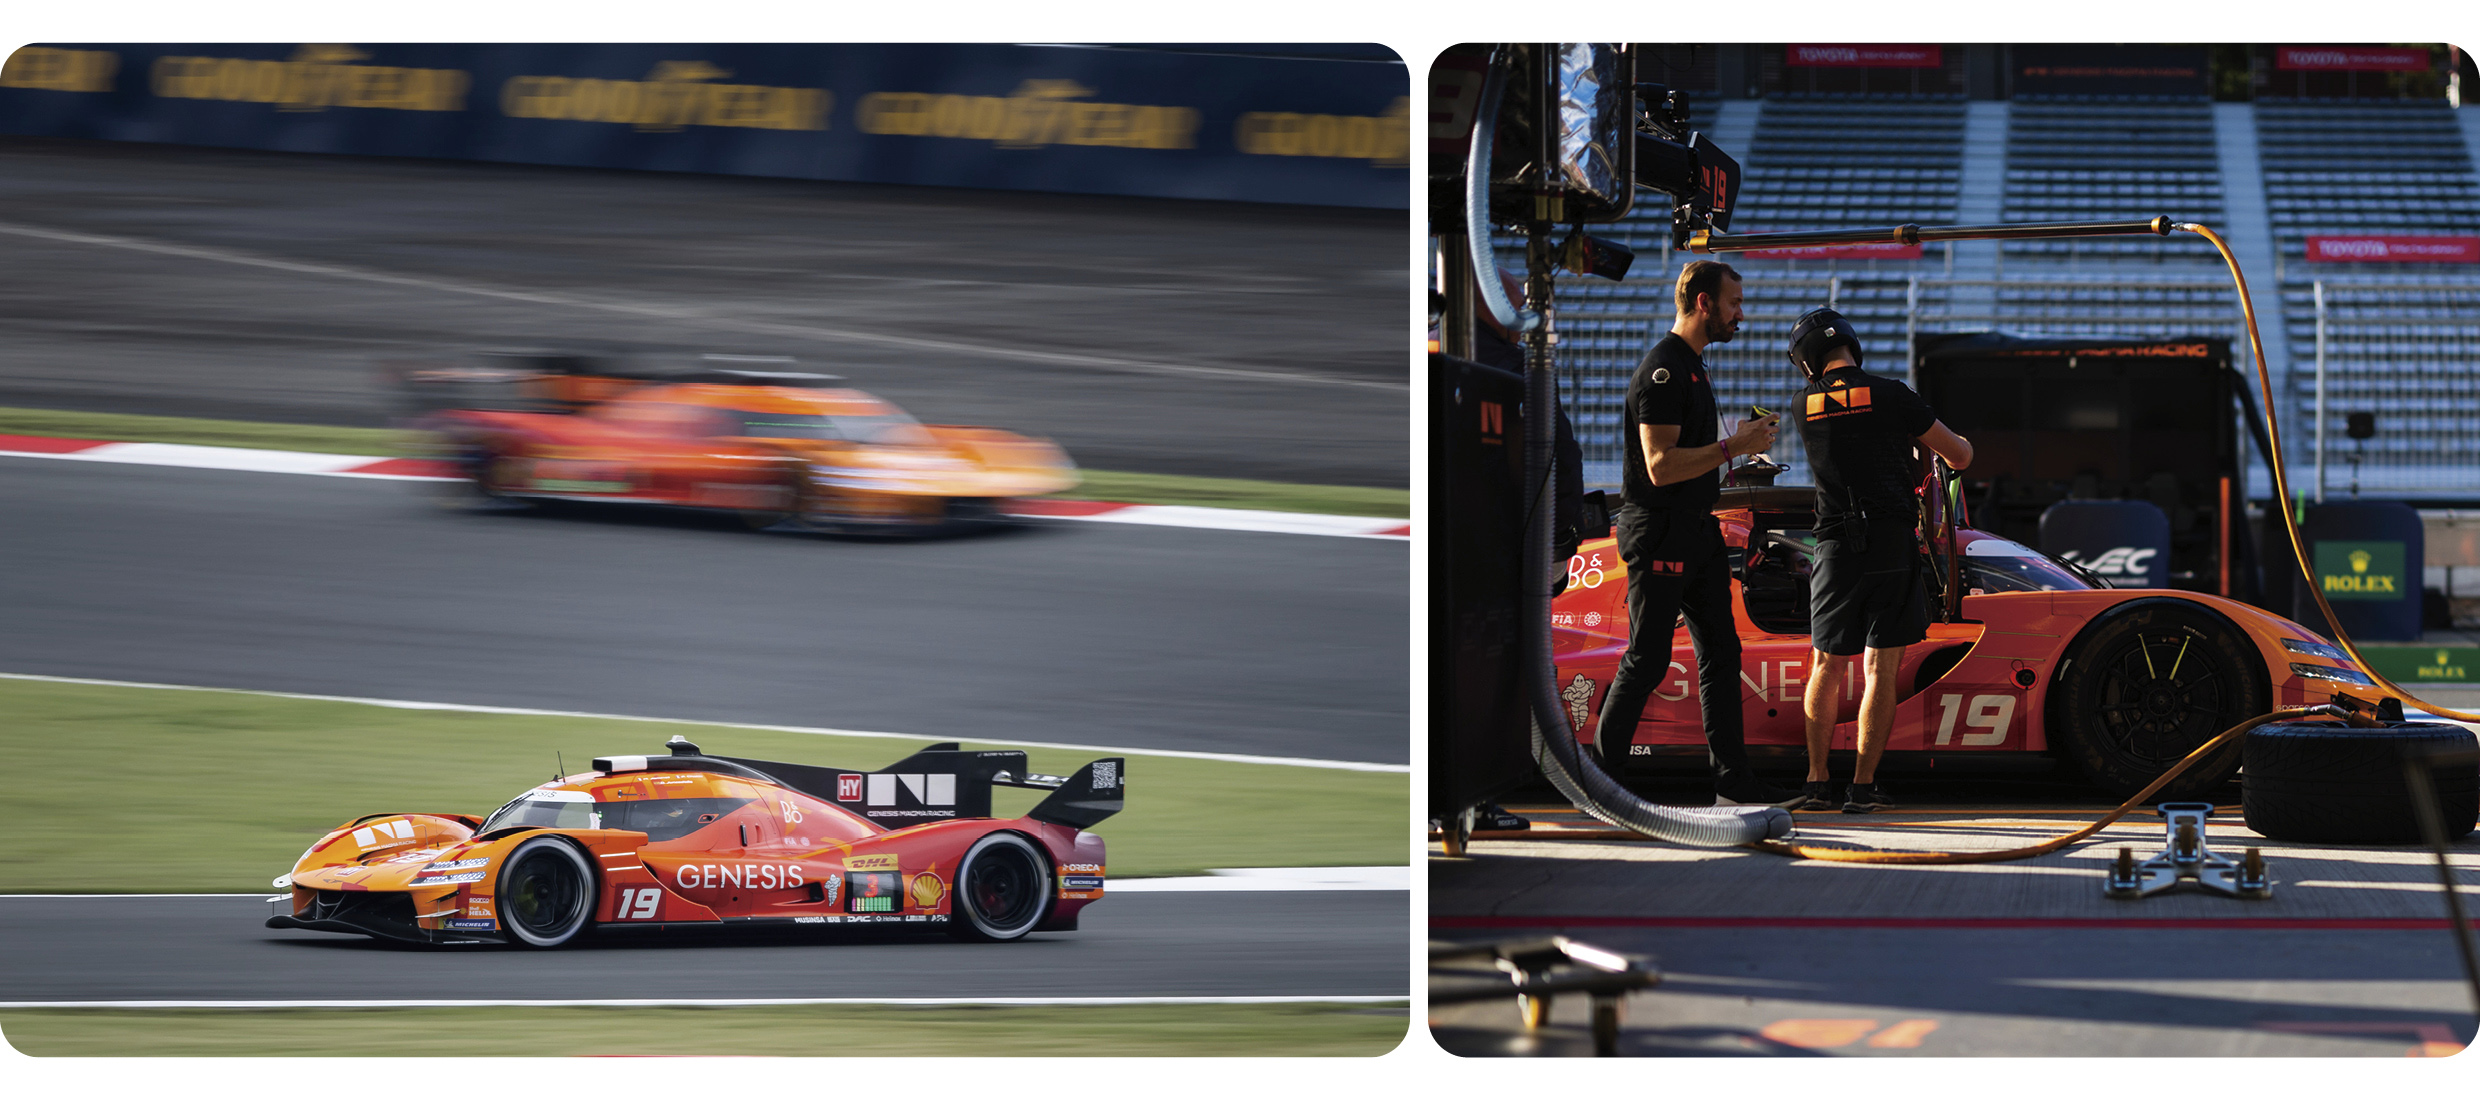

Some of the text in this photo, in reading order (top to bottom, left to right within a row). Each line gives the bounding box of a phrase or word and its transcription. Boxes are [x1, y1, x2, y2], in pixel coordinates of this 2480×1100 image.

[2324, 574, 2395, 592] ROLEX
[1552, 615, 1573, 624] FIA
[1934, 693, 2017, 746] 19
[839, 779, 860, 797] HY
[851, 858, 891, 868] DHL
[1068, 863, 1101, 872] ORECA
[676, 864, 804, 890] GENESIS
[864, 874, 879, 898] 3
[617, 888, 662, 919] 19
